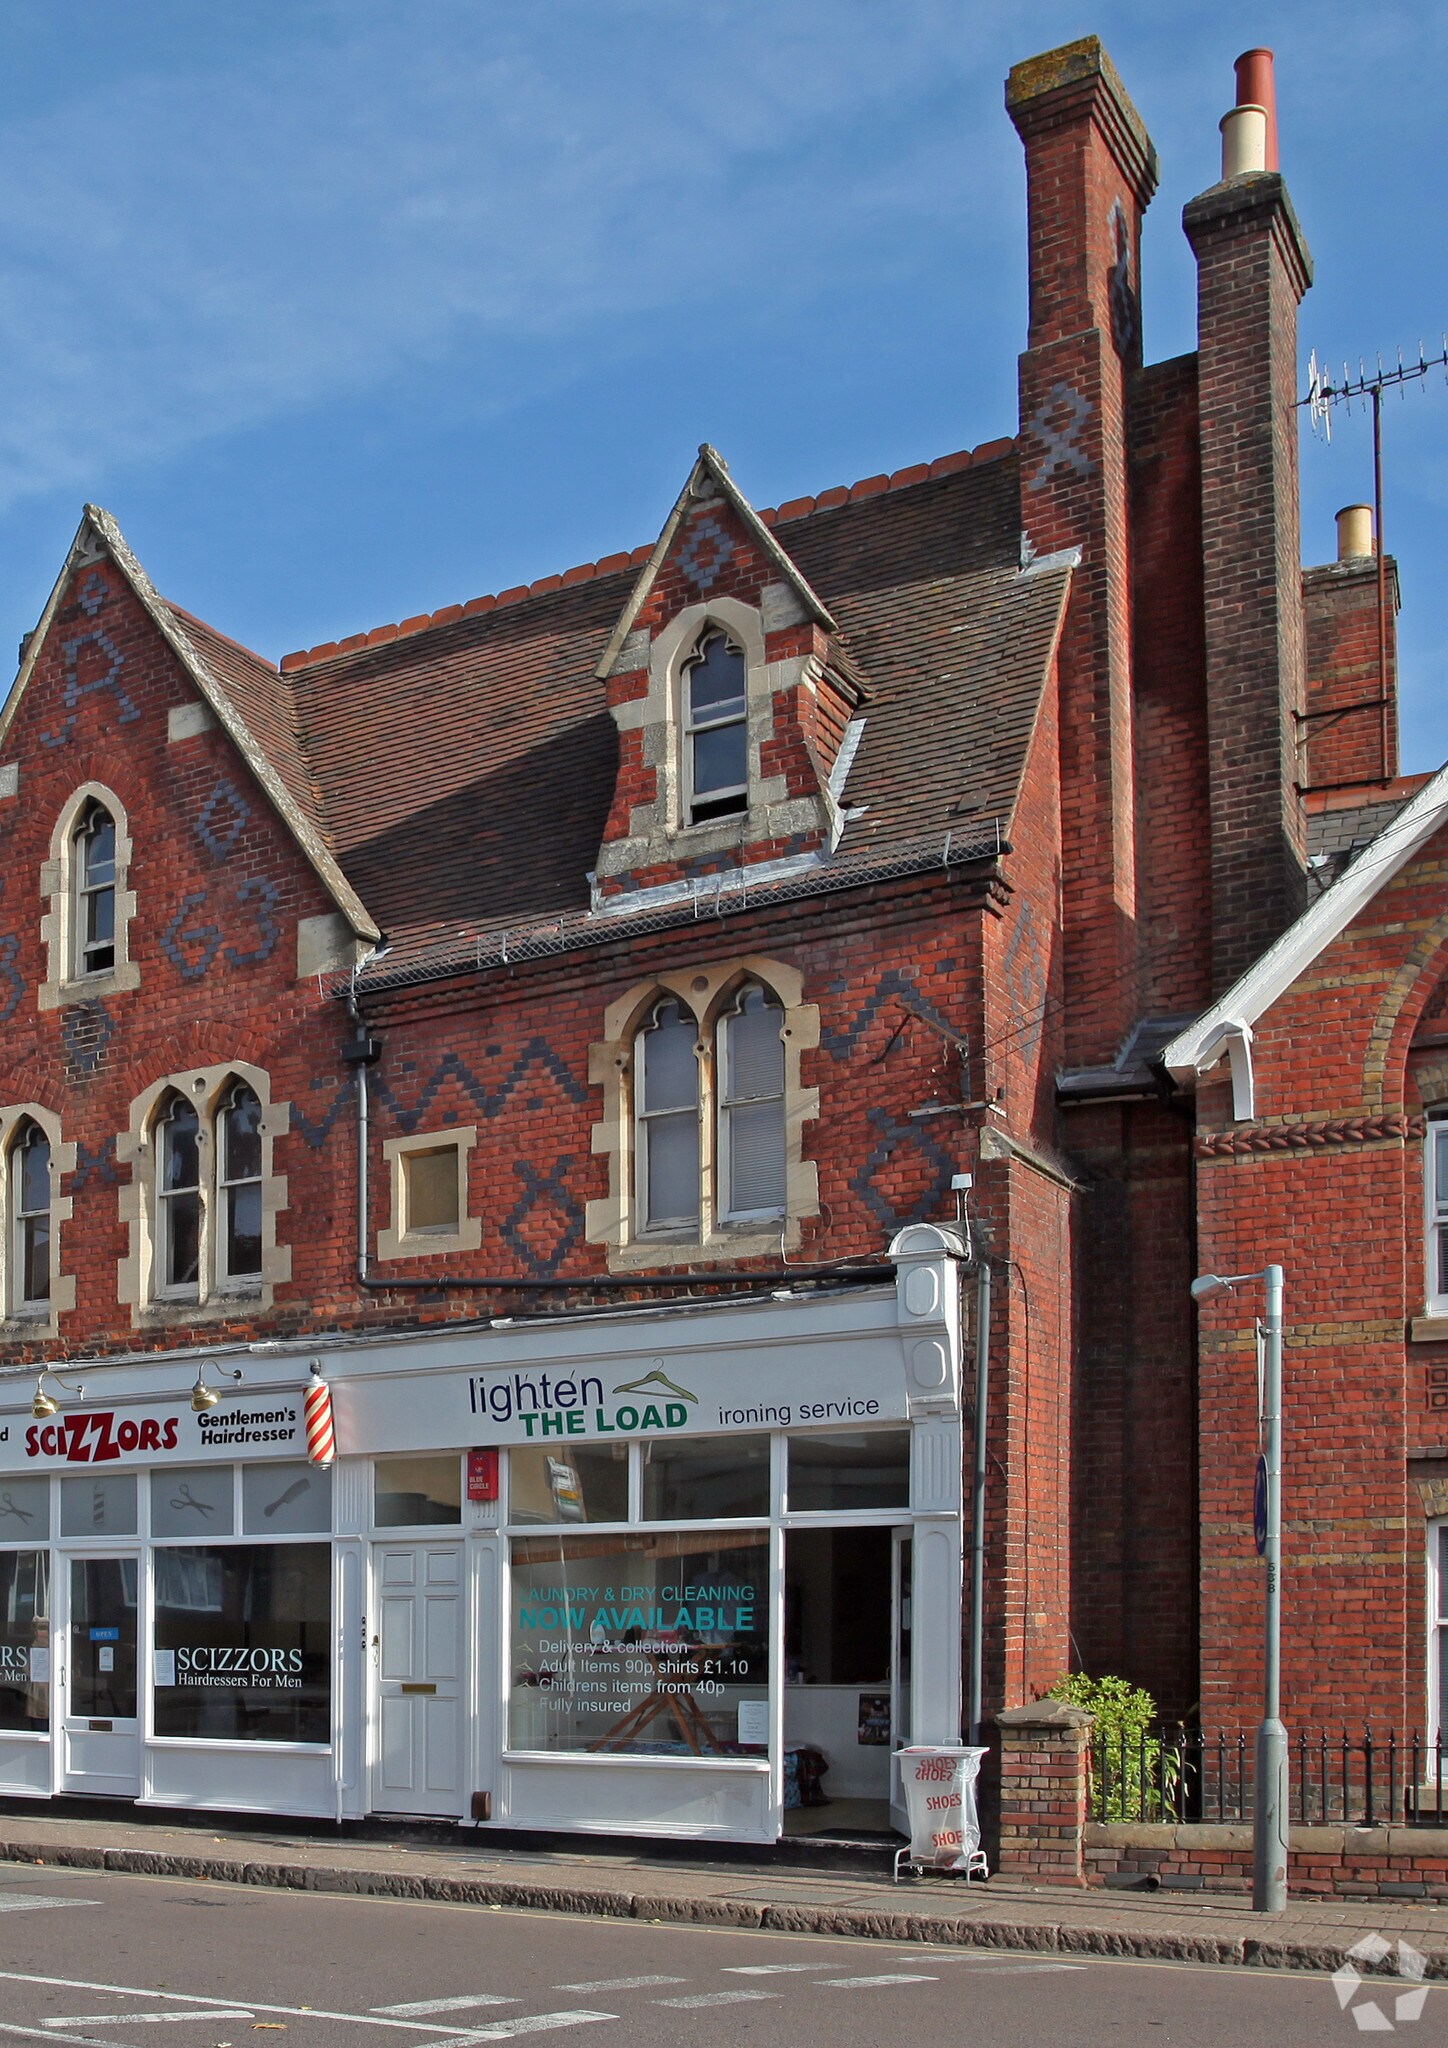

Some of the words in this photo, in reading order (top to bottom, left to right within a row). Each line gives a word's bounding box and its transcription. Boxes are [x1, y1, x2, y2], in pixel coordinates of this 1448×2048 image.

[469, 1373, 604, 1422] lighten
[197, 1406, 296, 1428] Gentlemen's
[518, 1409, 586, 1437] THE
[596, 1403, 688, 1433] LOAD
[719, 1404, 791, 1426] ironing
[799, 1397, 880, 1420] service
[201, 1422, 296, 1445] Hairdresser
[520, 1586, 600, 1602] LAUNDRY
[603, 1586, 616, 1602] &
[621, 1586, 657, 1601] DRY
[661, 1585, 755, 1601] CLEANING
[519, 1606, 586, 1630] NOW
[592, 1606, 754, 1631] AVAILABLE
[539, 1639, 597, 1657] Delivery
[602, 1639, 613, 1654] &
[617, 1639, 688, 1655] collection
[177, 1647, 303, 1673] SCIZZORS
[539, 1658, 576, 1673] Adult
[581, 1659, 620, 1673] Items
[625, 1659, 656, 1677] 90p,
[658, 1659, 699, 1674] shirts
[703, 1659, 749, 1675] £1.10
[4, 1669, 27, 1682] Men
[178, 1672, 248, 1687] Hairdressers
[251, 1674, 272, 1688] For
[275, 1674, 303, 1688] Men
[539, 1677, 608, 1693] Childrens
[612, 1679, 652, 1694] items
[656, 1679, 691, 1694] from
[696, 1680, 725, 1698] 40p
[540, 1697, 573, 1715] Fully
[577, 1698, 632, 1713] insured
[925, 1793, 963, 1811] SHOES
